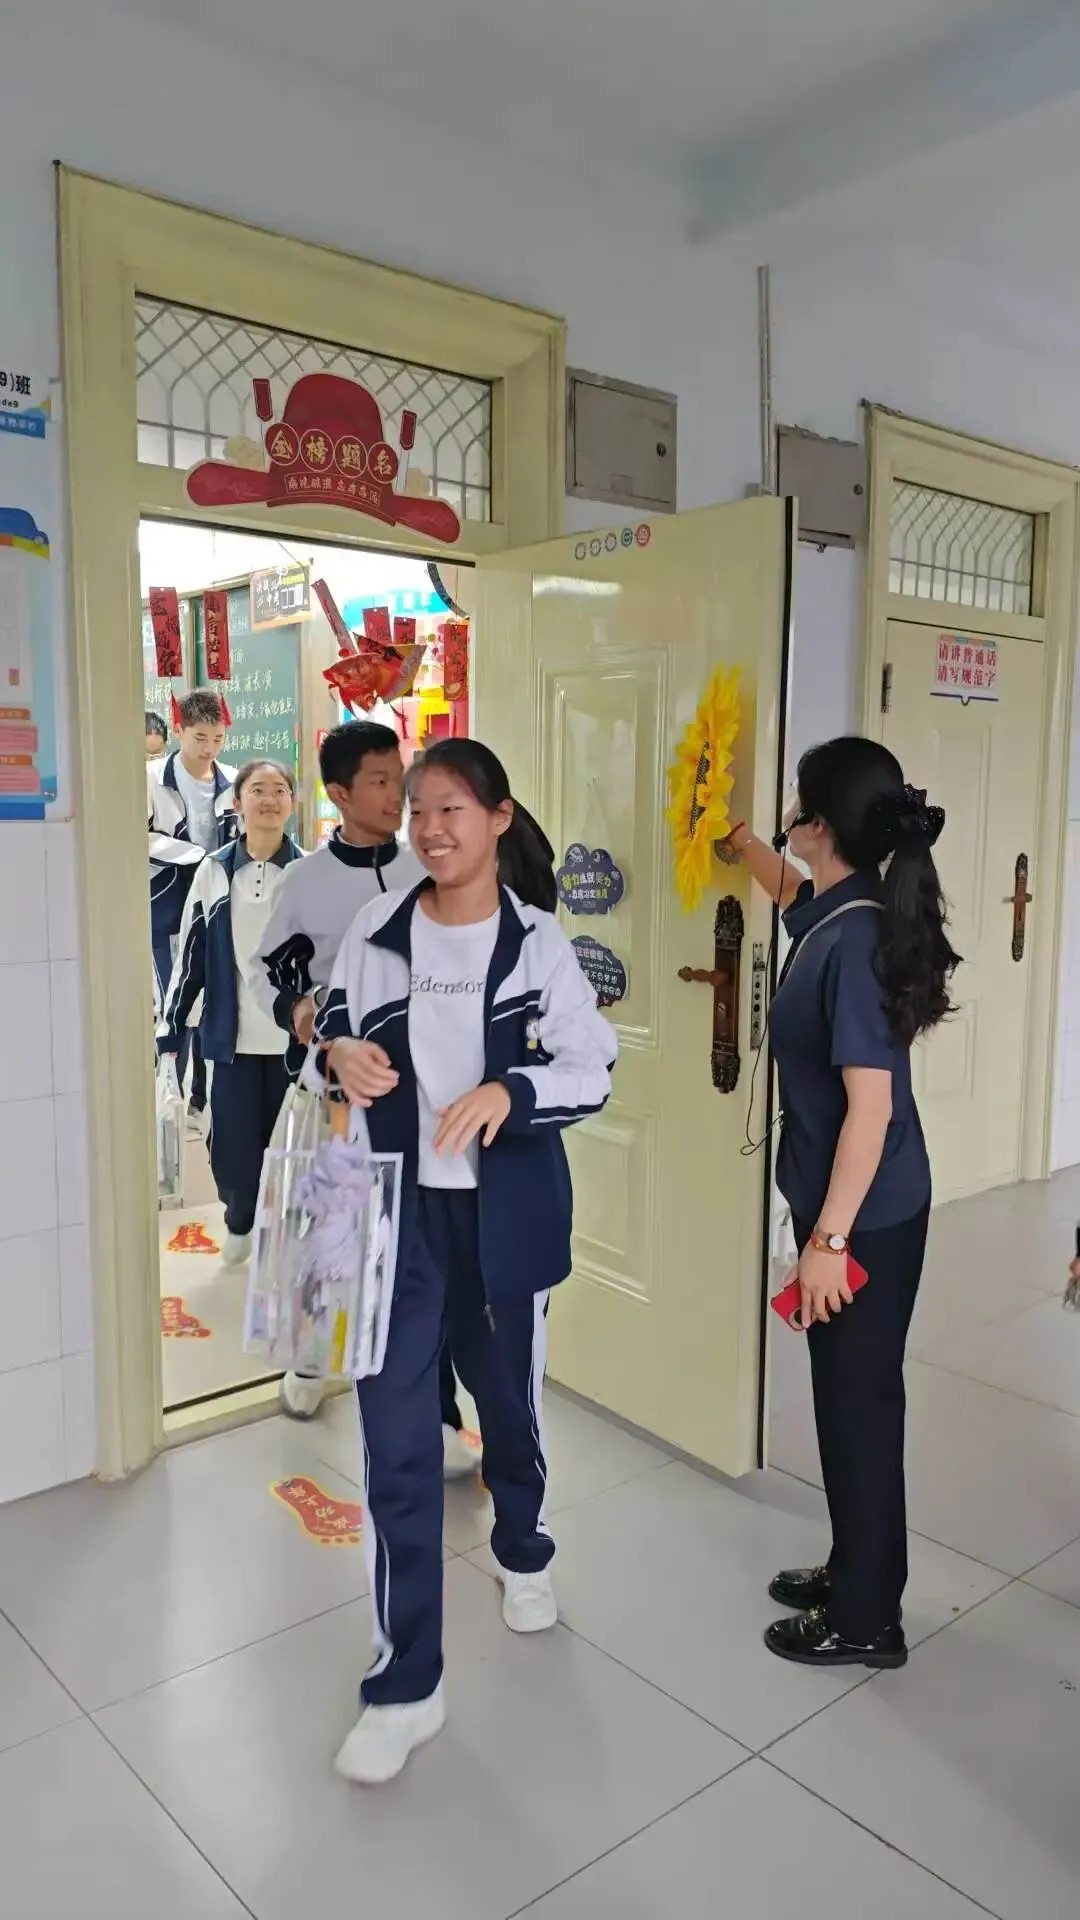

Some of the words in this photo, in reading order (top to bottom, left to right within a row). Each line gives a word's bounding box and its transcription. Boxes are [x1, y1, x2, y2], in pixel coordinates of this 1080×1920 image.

[939, 643, 996, 667] 请讲普通话
[937, 663, 996, 687] 请写规范字
[410, 974, 484, 995] Edensor
